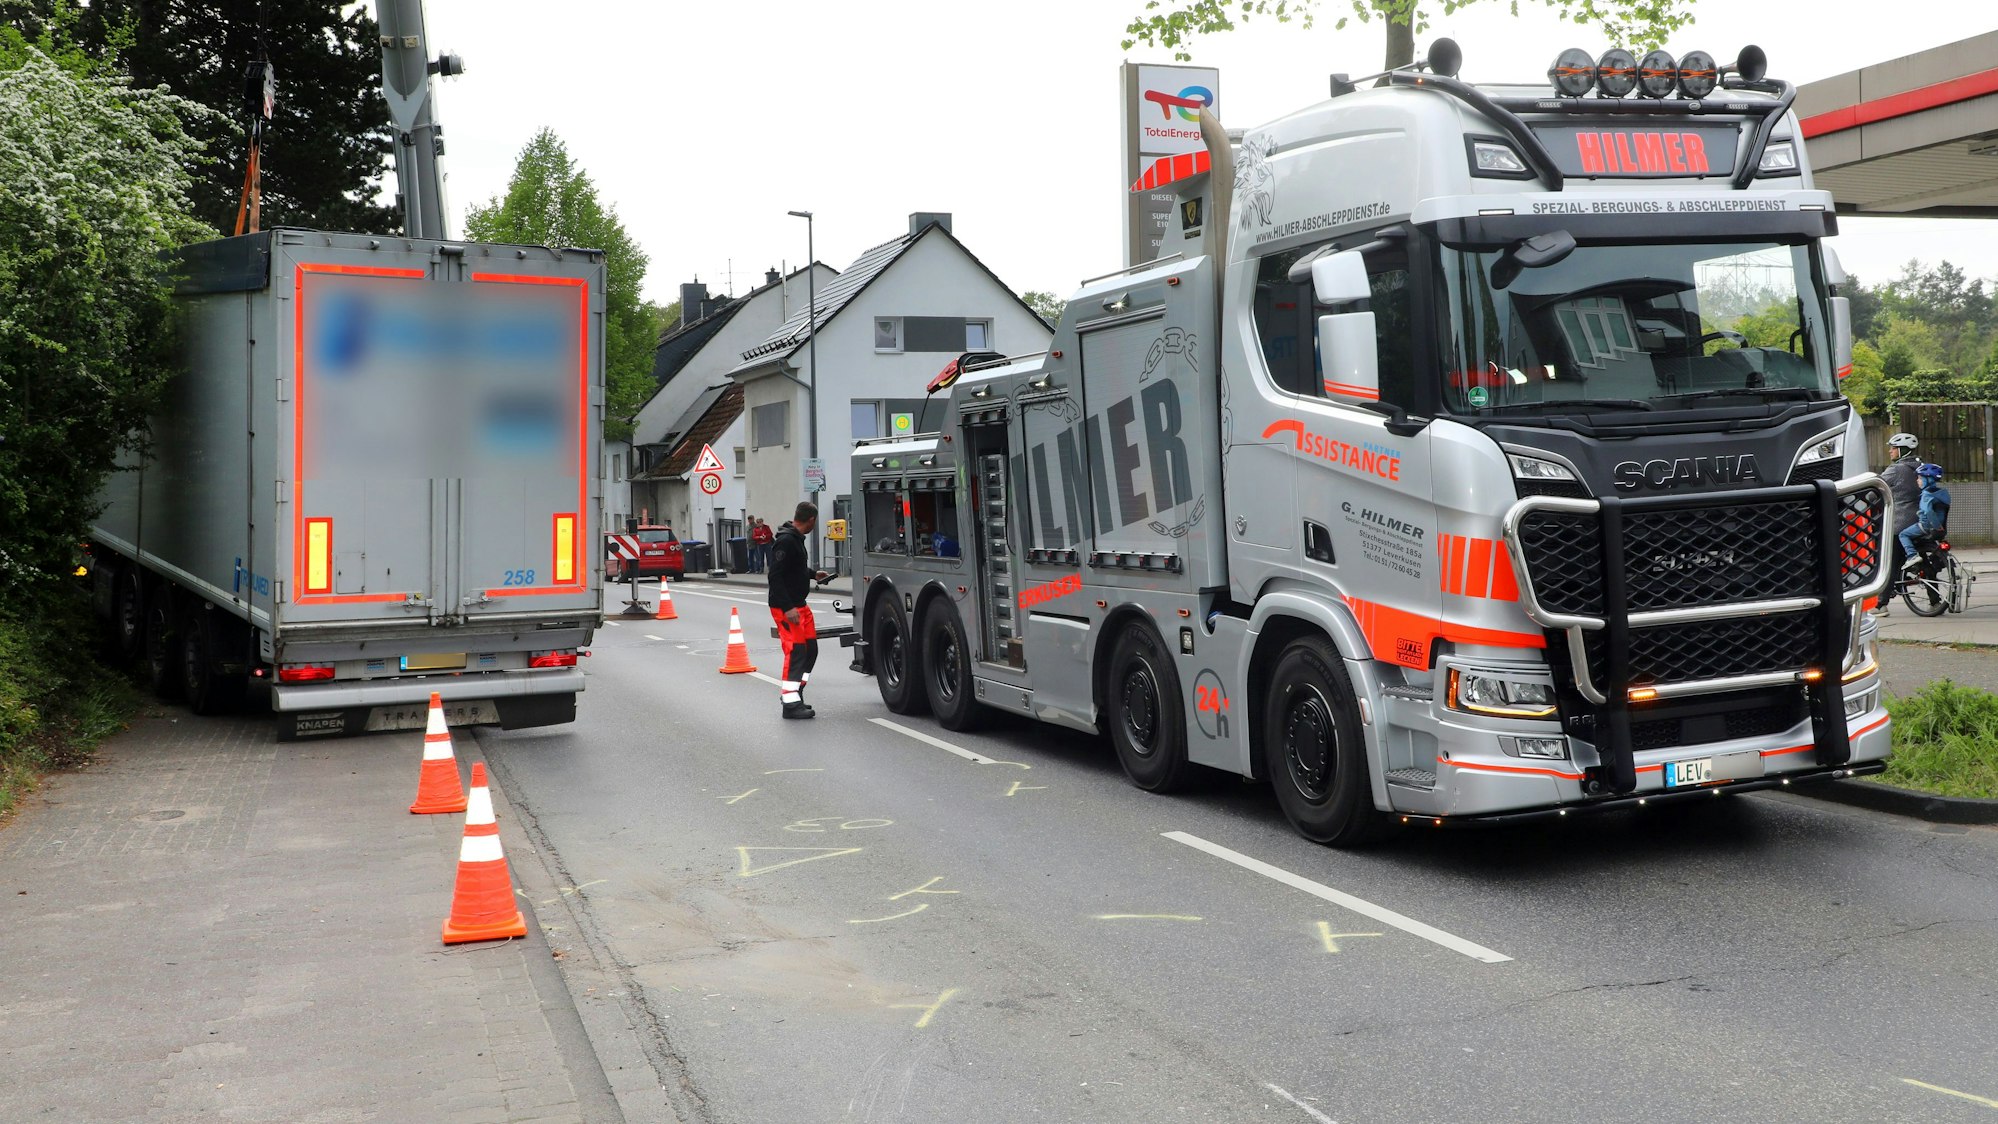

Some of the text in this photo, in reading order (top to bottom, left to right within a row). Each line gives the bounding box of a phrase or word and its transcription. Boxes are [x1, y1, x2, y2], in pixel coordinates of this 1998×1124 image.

[1576, 133, 1709, 173] HILMER
[1151, 194, 1173, 202] DIESEL
[1532, 200, 1786, 214] SPEZIAL- BERGUNGS- & ABSCHLEPPDIENST
[1255, 201, 1391, 243] www.HILMER-ABSCHLEPPDIENST.de
[1262, 419, 1401, 481] ASSISTANCE
[1363, 441, 1401, 459] PARTNER
[1614, 454, 1764, 491] SCANIA
[705, 478, 718, 489] 30
[1341, 501, 1424, 540] G. HILMER
[1362, 541, 1422, 569] 51377 Leverkusen
[1406, 547, 1422, 559] 185a
[504, 569, 535, 586] 258
[1397, 638, 1422, 653] BITTE
[1198, 685, 1220, 714] 24
[384, 707, 478, 720] TRAIERS
[296, 720, 344, 730] KNAPEN
[1677, 762, 1702, 783] LEV
